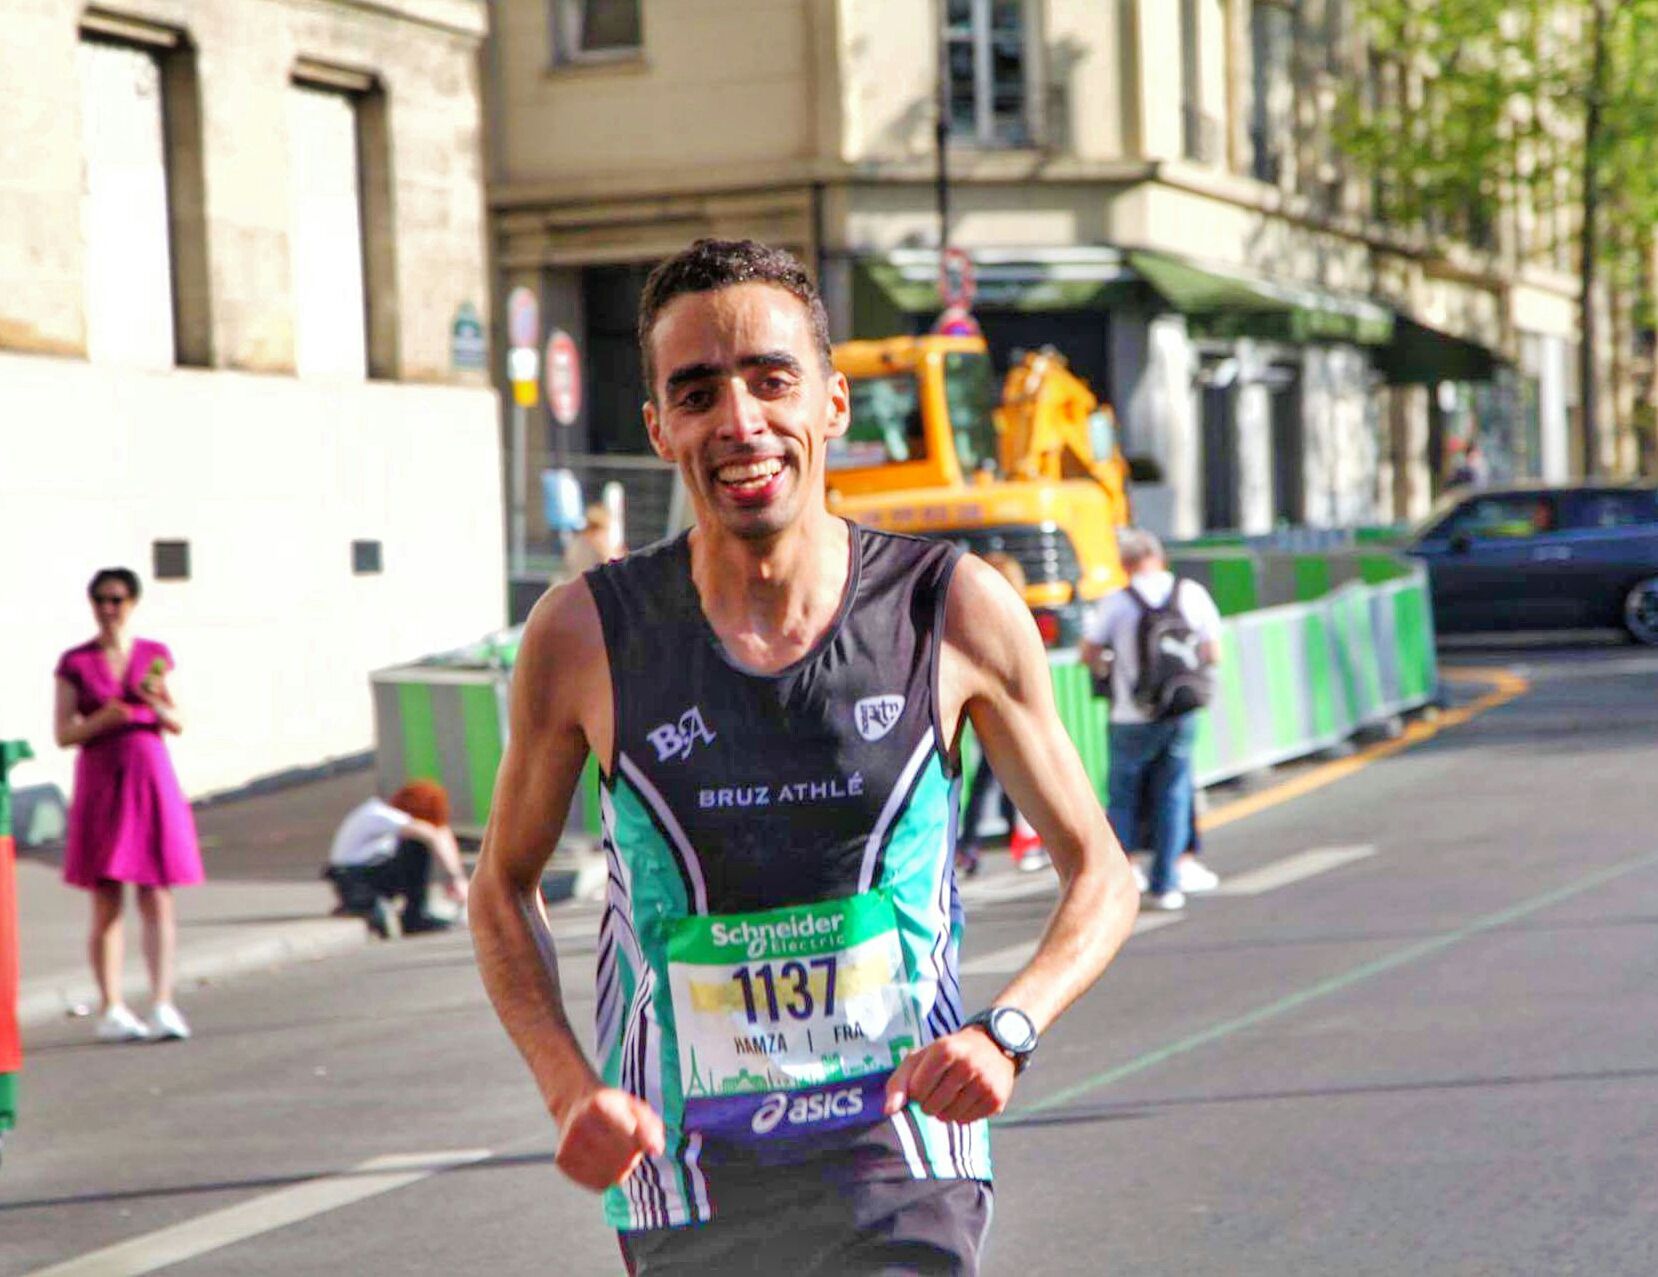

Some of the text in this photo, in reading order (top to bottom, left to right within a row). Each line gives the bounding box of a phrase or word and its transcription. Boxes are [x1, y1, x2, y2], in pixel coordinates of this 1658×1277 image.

[699, 770, 864, 808] BRUZ ATHLÉ
[711, 912, 845, 959] Schneider
[733, 957, 837, 1025] 1137
[733, 1032, 788, 1056] HAMZA
[832, 1020, 865, 1045] FRA
[787, 1087, 863, 1124] asics
